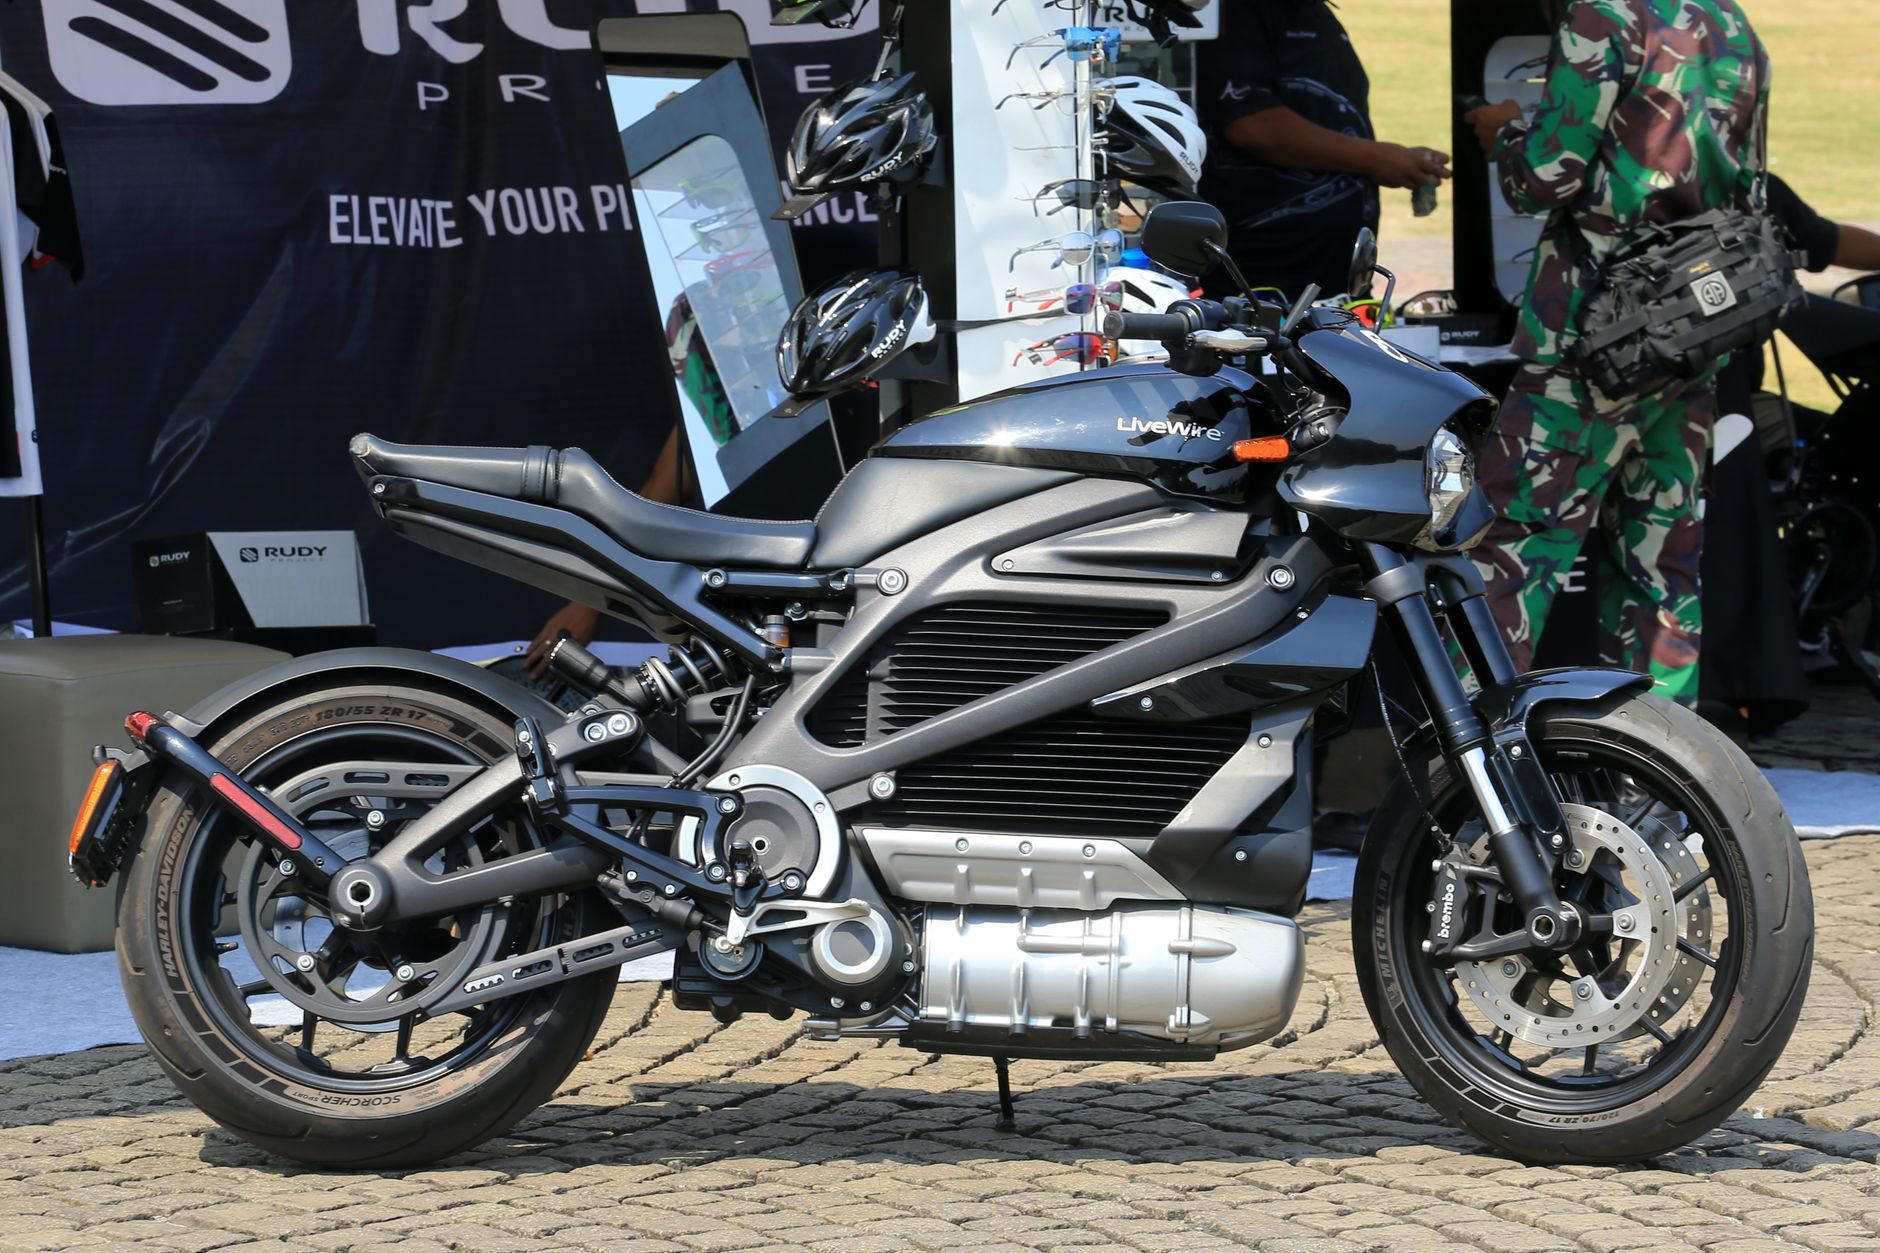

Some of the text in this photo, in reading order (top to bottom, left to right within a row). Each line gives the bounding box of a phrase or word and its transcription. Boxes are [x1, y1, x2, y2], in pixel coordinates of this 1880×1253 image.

[860, 151, 903, 182] RUDY
[329, 194, 463, 248] ELEVATE
[467, 186, 585, 236] YOUR
[871, 319, 907, 359] RUDY
[1116, 416, 1222, 442] LiveWire
[160, 551, 190, 562] RUDY
[264, 546, 327, 557] RUDY
[315, 705, 375, 723] 180/55
[379, 705, 404, 717] ZR
[407, 708, 427, 722] 17
[155, 804, 197, 979] HARLEY-DAVIDSON
[1374, 872, 1393, 979] MICHELIN
[1437, 883, 1456, 939] brembo
[320, 1093, 401, 1107] SCORCHER
